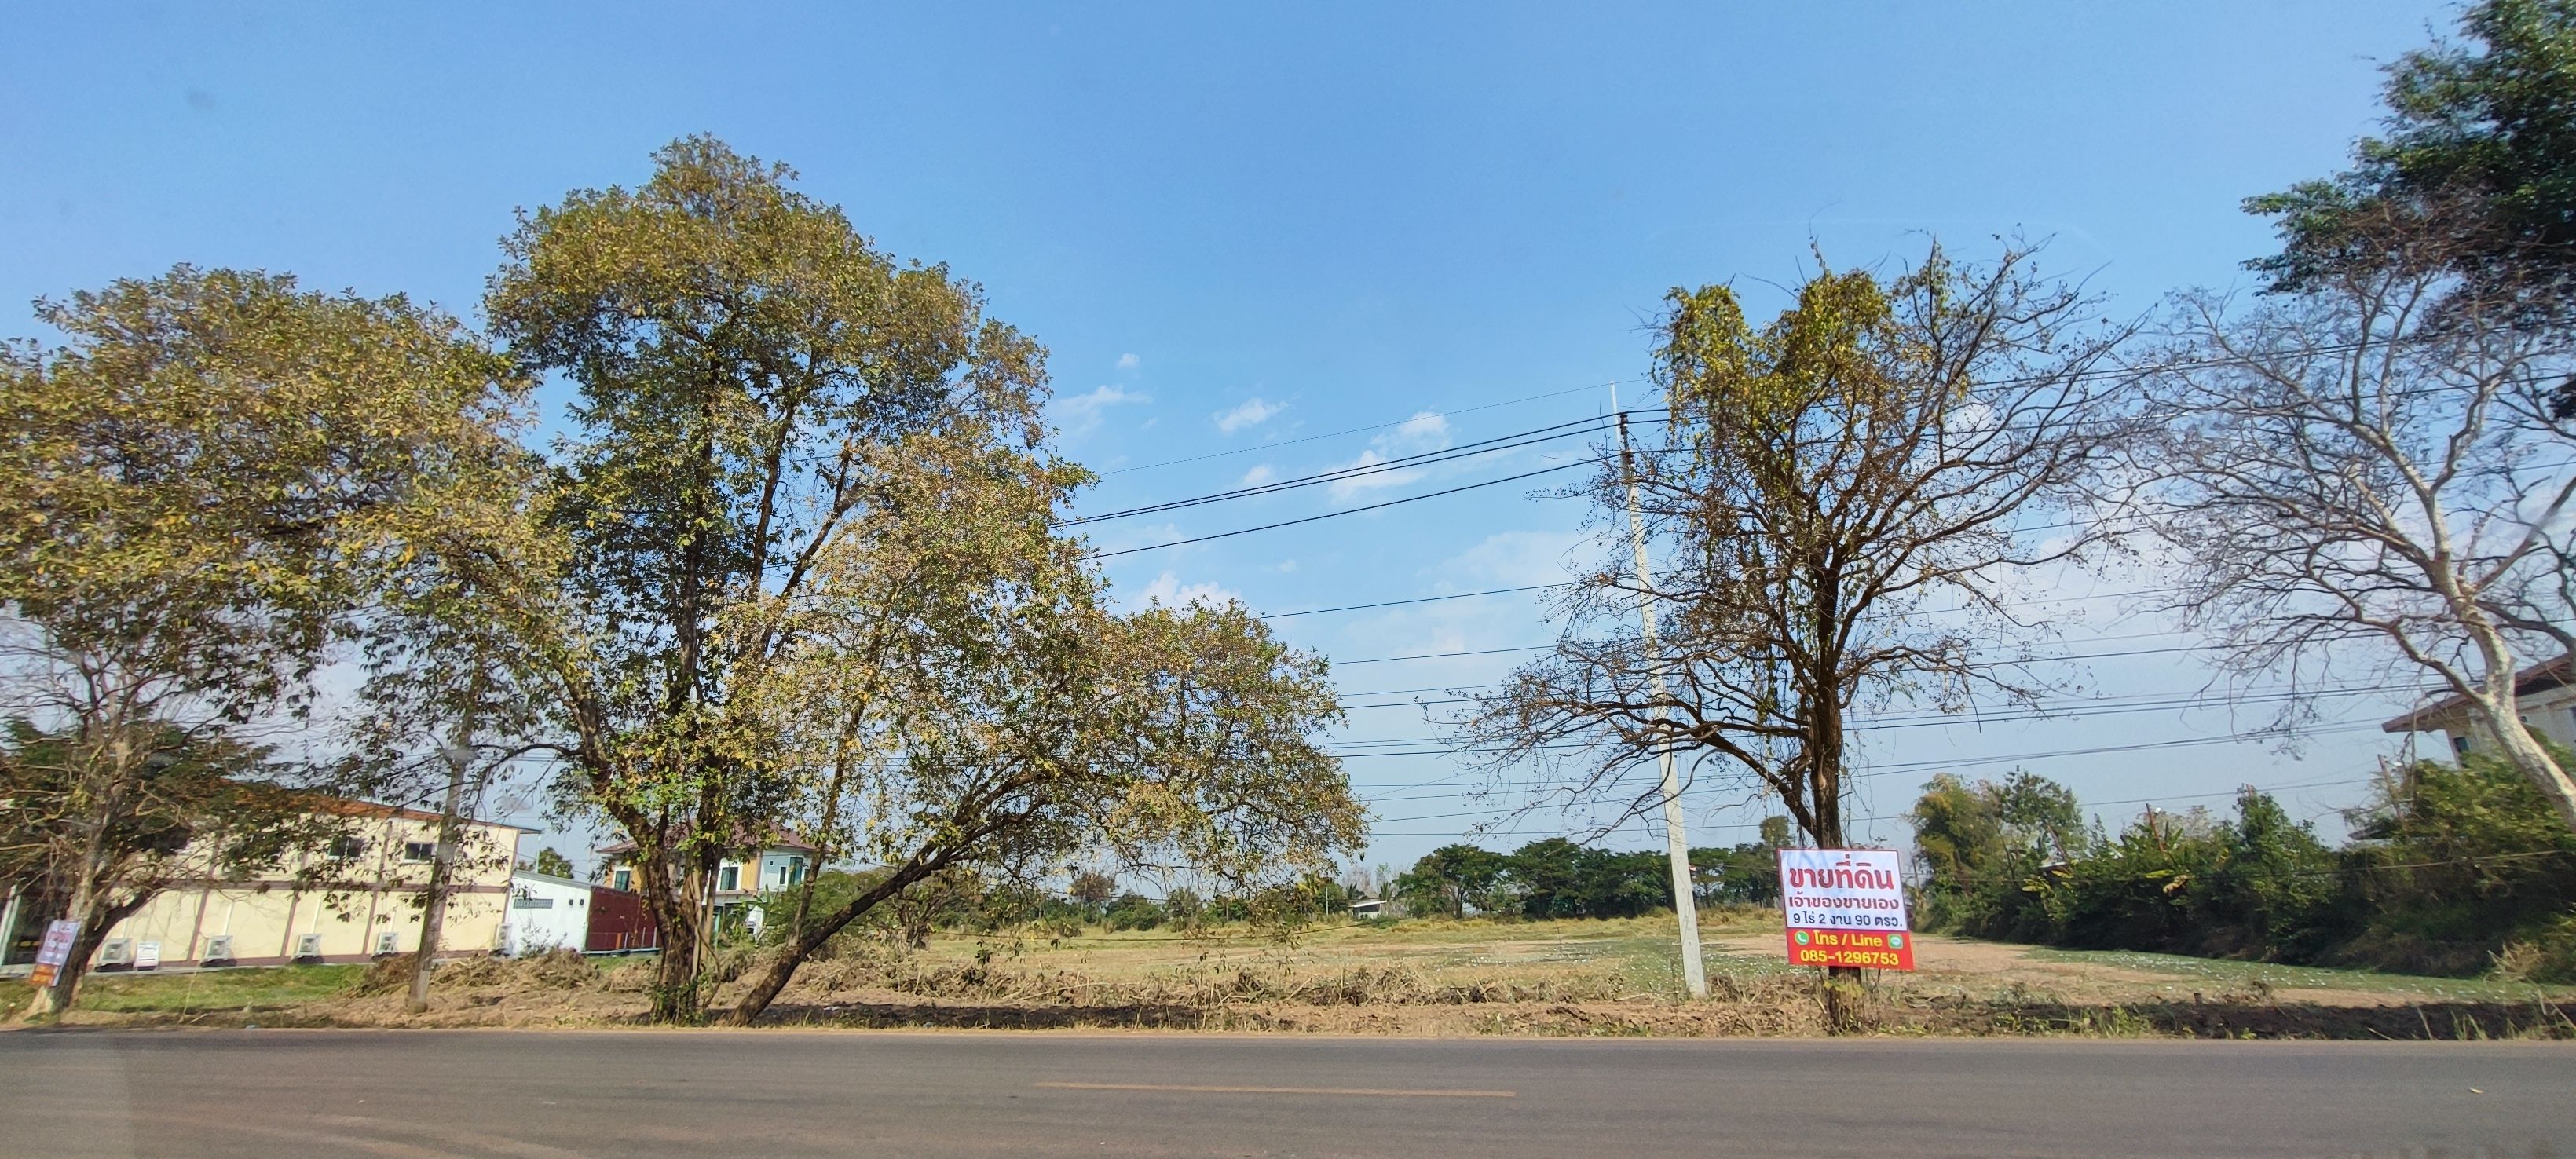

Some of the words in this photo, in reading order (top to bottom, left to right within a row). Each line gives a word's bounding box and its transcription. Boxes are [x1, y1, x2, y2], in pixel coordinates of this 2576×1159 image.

[1789, 854, 1894, 890] ขายที่ดิน
[1788, 891, 1899, 909] เจ้าของขายเอง
[1793, 912, 1801, 924] 9
[1803, 910, 1815, 924] ไร่
[1819, 913, 1826, 924] 2
[1830, 915, 1851, 925] งาน
[1855, 915, 1871, 926] 90
[1874, 916, 1903, 927] ตรว.
[1813, 930, 1839, 945] โทร
[1841, 933, 1848, 946] /
[1851, 934, 1883, 947] Line
[1799, 949, 1900, 966] 085-1296753
